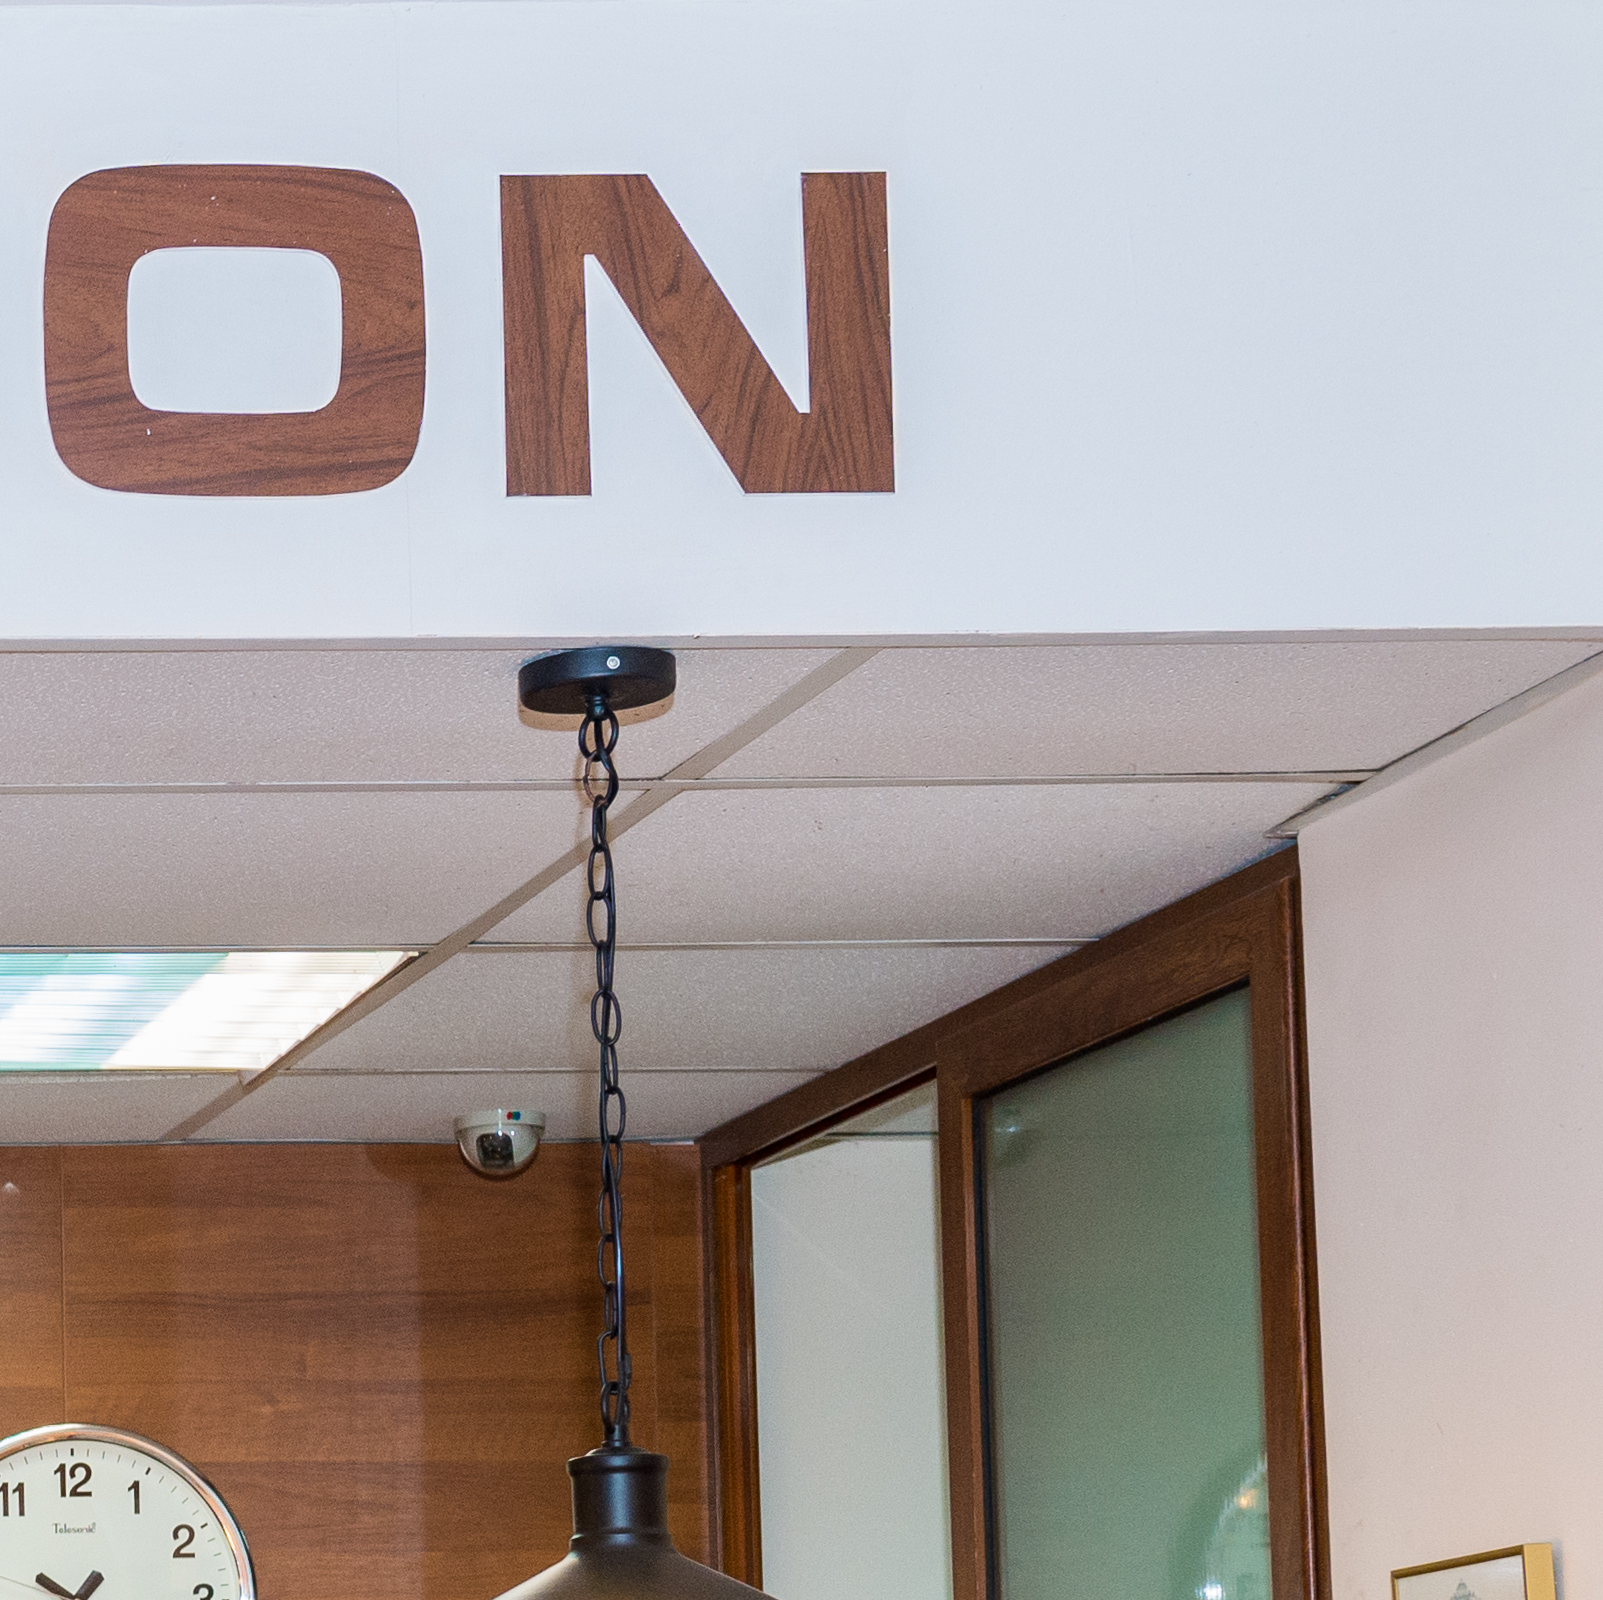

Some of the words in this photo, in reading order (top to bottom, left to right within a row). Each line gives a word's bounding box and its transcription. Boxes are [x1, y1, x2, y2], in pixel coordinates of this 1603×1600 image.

[53, 1462, 93, 1498] 12
[127, 1480, 141, 1515] 1
[172, 1524, 196, 1559] 2
